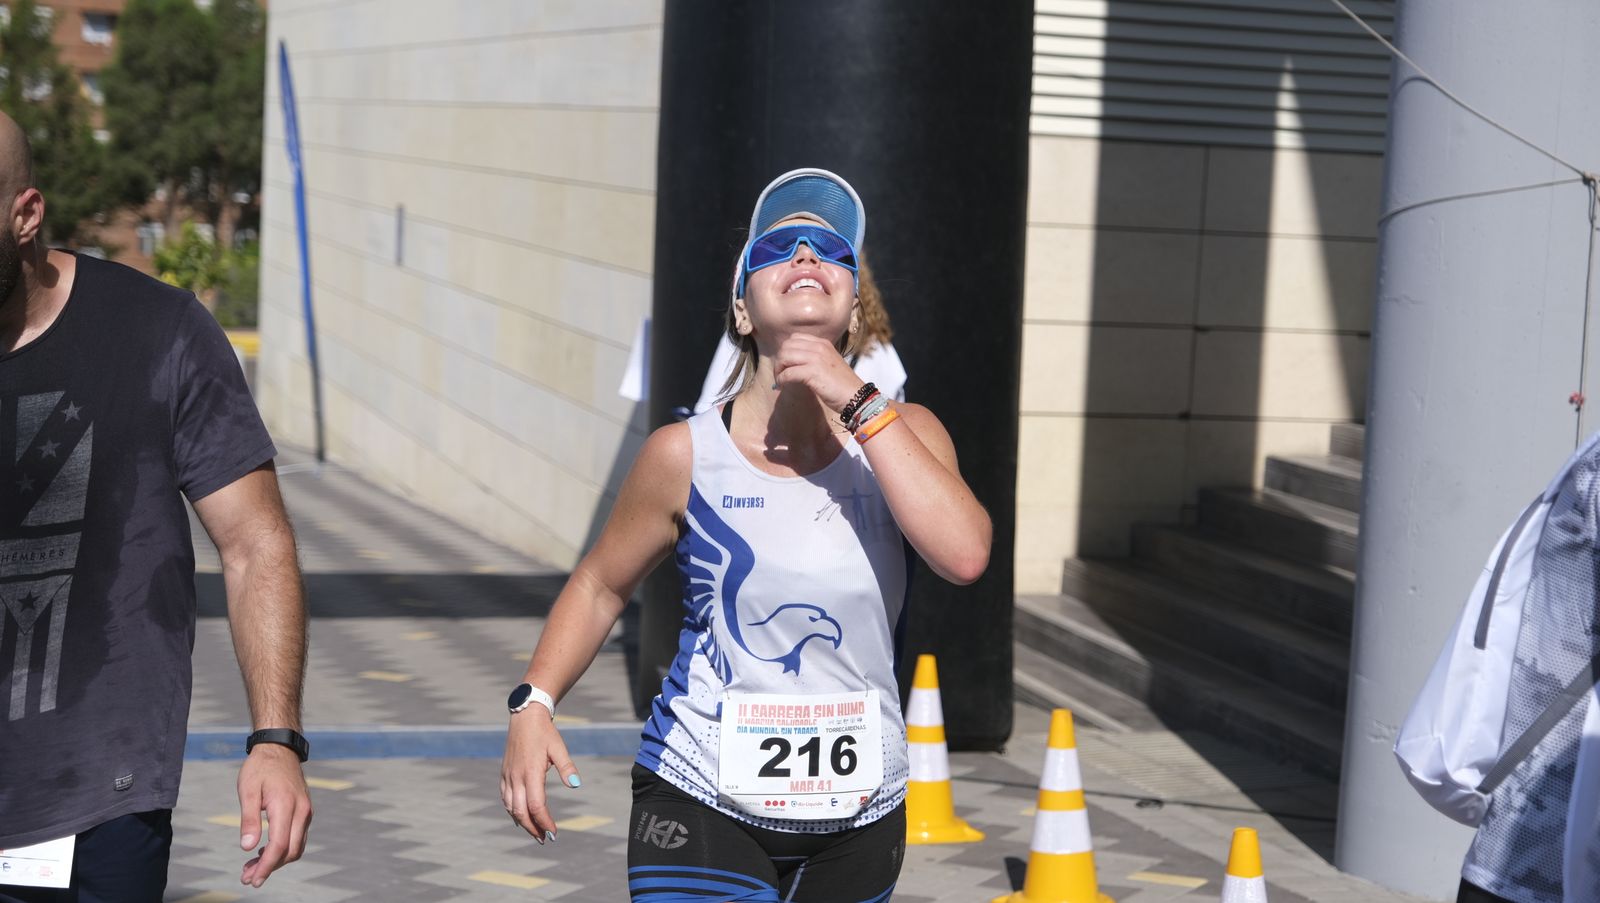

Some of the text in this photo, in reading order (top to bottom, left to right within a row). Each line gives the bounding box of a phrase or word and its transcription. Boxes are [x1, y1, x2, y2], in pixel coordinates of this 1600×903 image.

[738, 701, 865, 719] II CARRERA SIN HUMO
[776, 719, 818, 727] SALUDABLE
[749, 726, 780, 735] MUNDIAL
[781, 727, 793, 735] SIN
[794, 726, 819, 735] TABACO
[757, 734, 858, 778] 216
[790, 779, 832, 792] MAR 4.1
